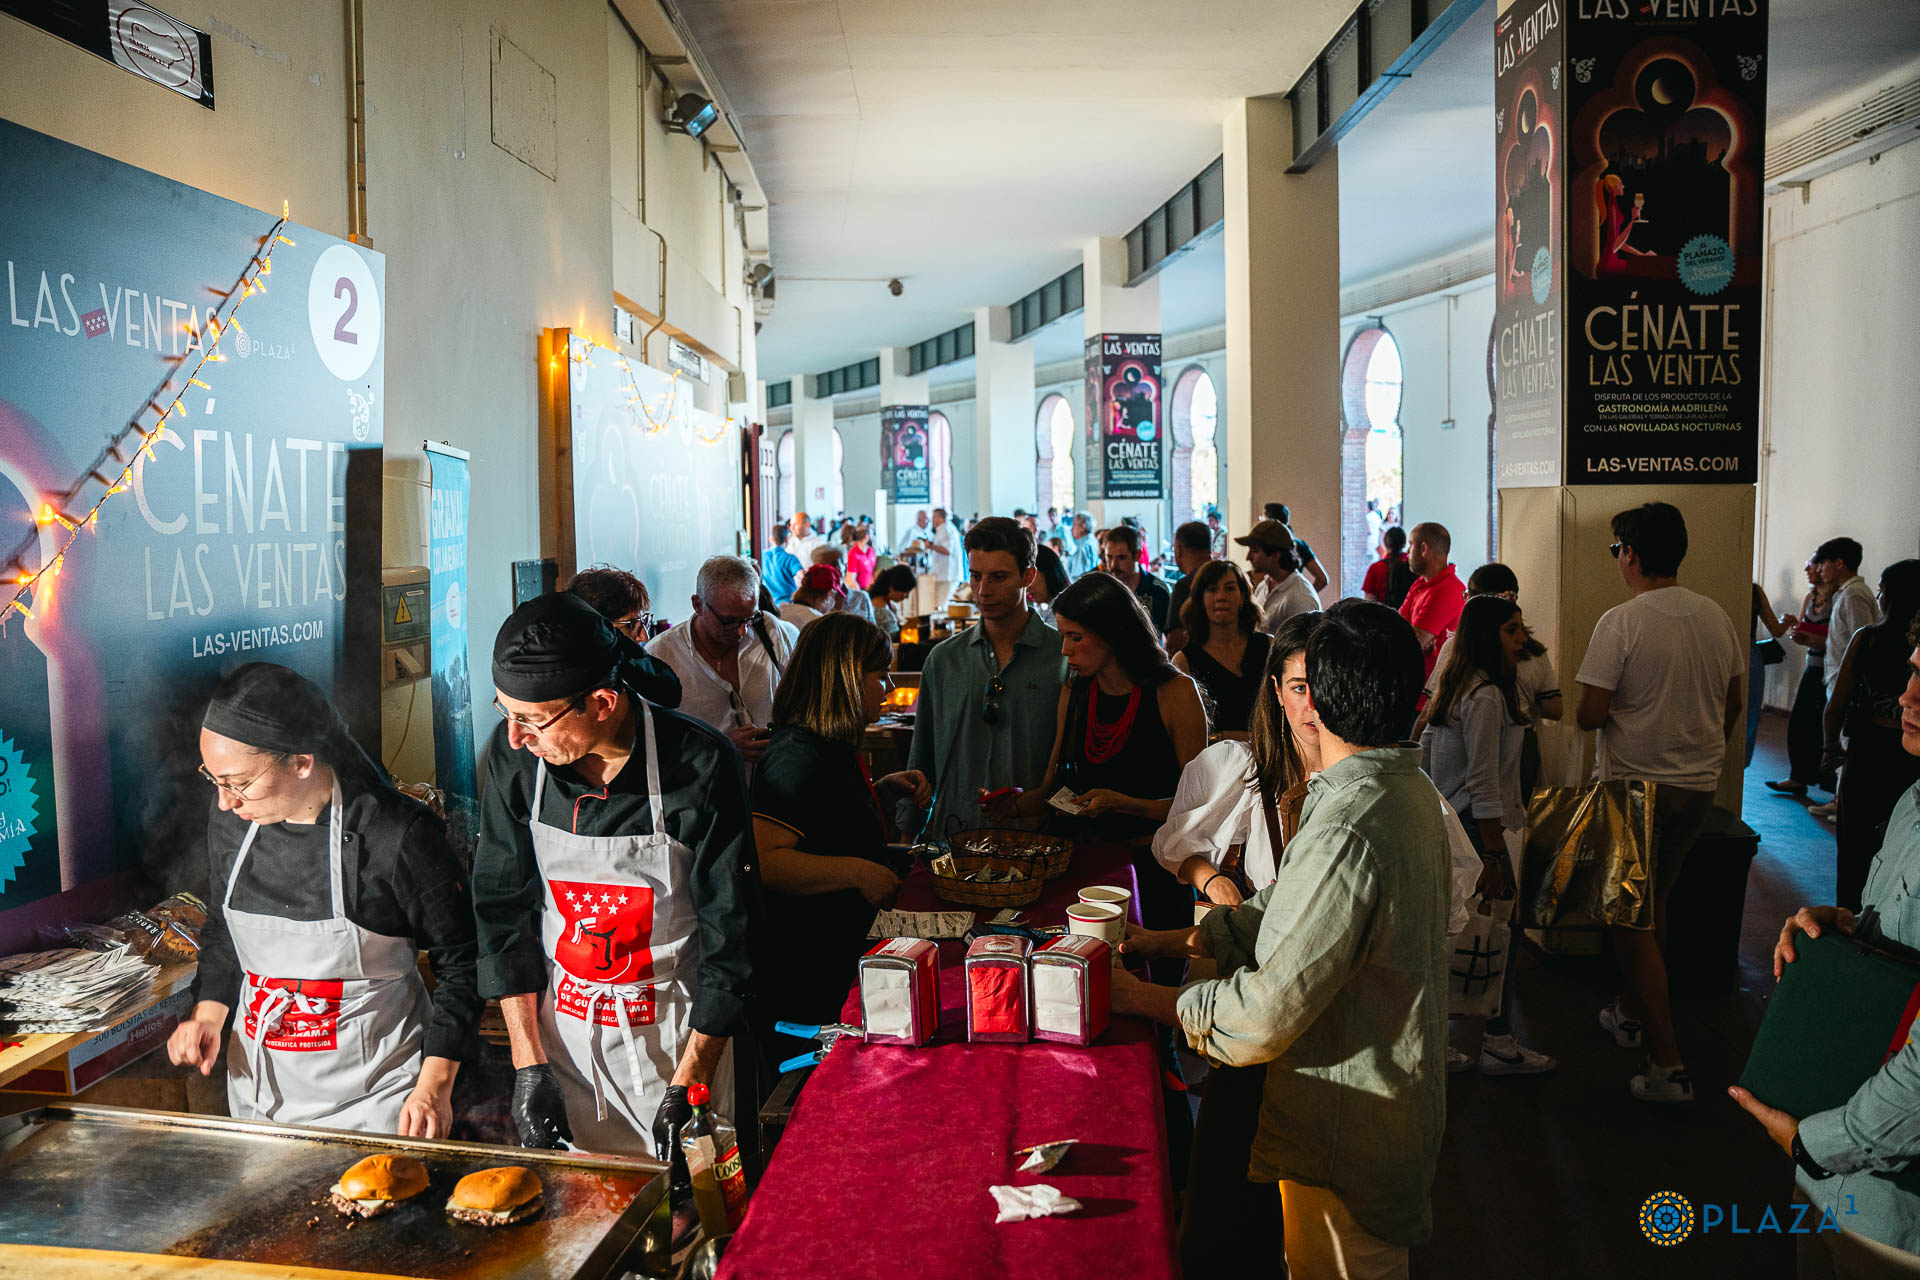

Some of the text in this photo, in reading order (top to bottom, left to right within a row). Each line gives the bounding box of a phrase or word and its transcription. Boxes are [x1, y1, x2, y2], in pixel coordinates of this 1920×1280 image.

[1497, 33, 1515, 77] LAS
[1519, 0, 1559, 54] VENTAS
[1684, 246, 1725, 261] PLANAZO
[8, 261, 222, 358] LAS VENTAS
[333, 276, 359, 346] 2
[1584, 290, 1741, 351] CÉNATE
[1104, 341, 1122, 355] LAS
[1124, 341, 1160, 356] VENTAS
[1500, 309, 1555, 368] CÉNATE
[1502, 358, 1557, 399] LAS VENTAS
[1589, 353, 1742, 386] LAS VENTAS
[1594, 392, 1631, 401] DISFRUTA
[1632, 392, 1643, 401] DE
[1644, 392, 1659, 401] LOS
[1660, 392, 1708, 401] PRODUCTOS
[1597, 401, 1728, 413] GASTRONOMÍA MADRILEÑA
[1583, 422, 1742, 433] CON LAS NOVILLADAS NOCTURNAS
[1107, 438, 1158, 459] CÉNATE
[133, 397, 346, 536] CÉNATE
[1109, 458, 1159, 470] LAS VENTAS
[1586, 456, 1739, 472] LAS-VENTAS.COM
[145, 539, 348, 621] LAS VENTAS
[192, 620, 324, 658] LAS-VENTAS.COM
[560, 992, 571, 1003] DE
[574, 998, 649, 1013] GUDARAMA
[110, 1009, 147, 1036] BOLSITAS
[130, 1020, 162, 1040] Helios
